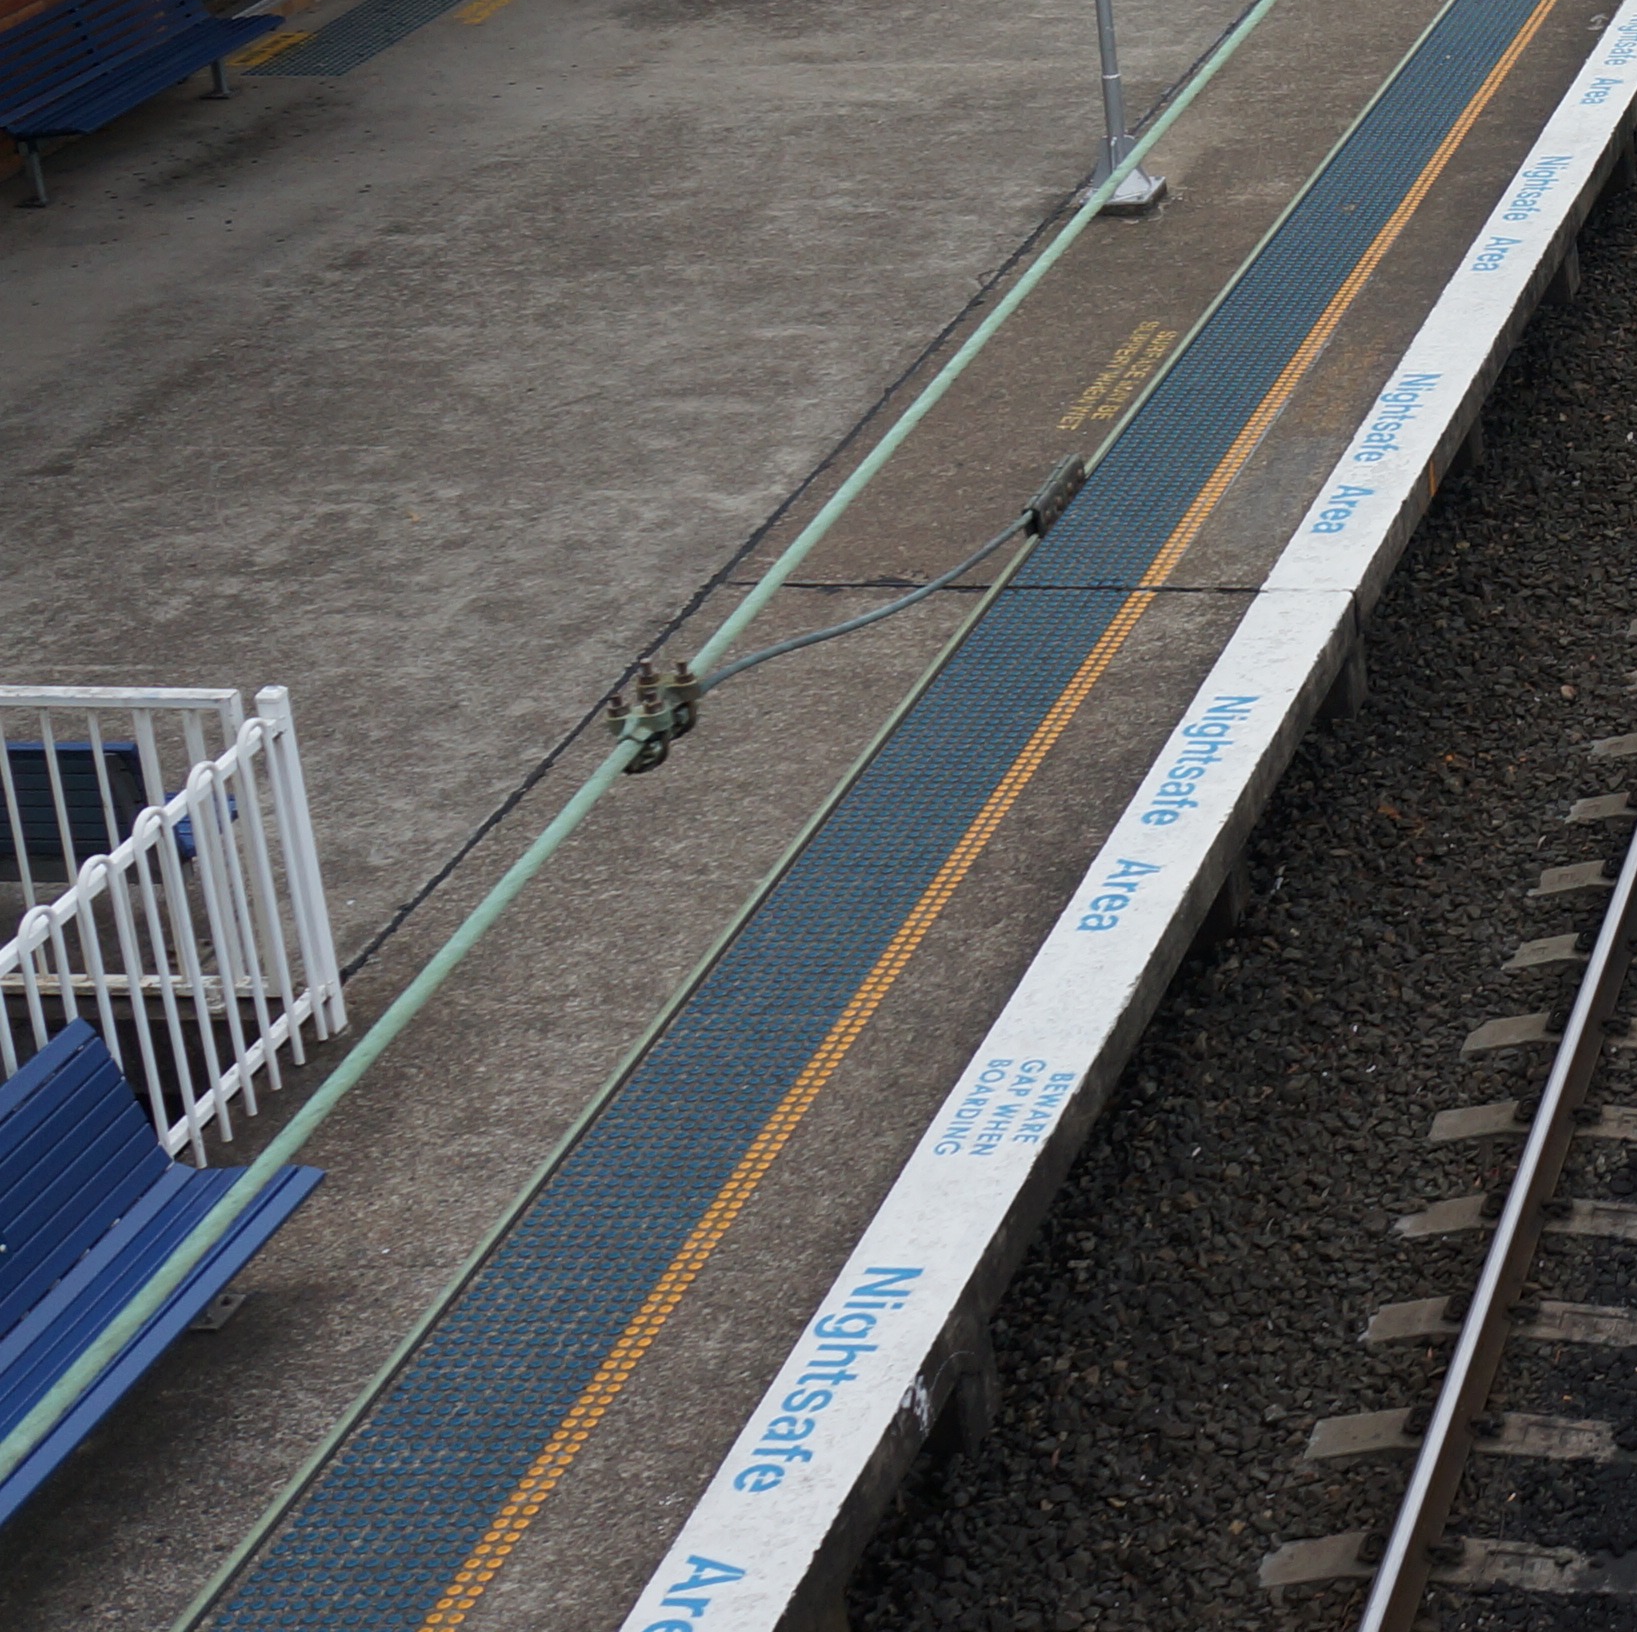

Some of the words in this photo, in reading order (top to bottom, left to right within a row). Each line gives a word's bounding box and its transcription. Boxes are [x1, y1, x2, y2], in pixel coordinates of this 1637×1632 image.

[1579, 77, 1625, 106] Area
[1502, 155, 1573, 222] Nightsafe
[1470, 236, 1523, 273] Area
[1105, 320, 1160, 368] SLIPPERY
[1123, 330, 1178, 378] SURFACE
[1077, 370, 1121, 403] WHEN
[1105, 380, 1141, 403] MAY
[1056, 404, 1093, 431] WET
[1090, 404, 1121, 420] BE
[1352, 373, 1442, 463] Nightsafe
[1310, 484, 1376, 535] Area
[1139, 695, 1260, 827] Nightsafe
[1076, 857, 1162, 932] Area
[1008, 1059, 1047, 1097] GAP
[933, 1059, 1014, 1156] BOARDING
[968, 1103, 1025, 1156] WHEN
[1013, 1072, 1076, 1144] BEWARE
[732, 1266, 925, 1493] Nightsafe
